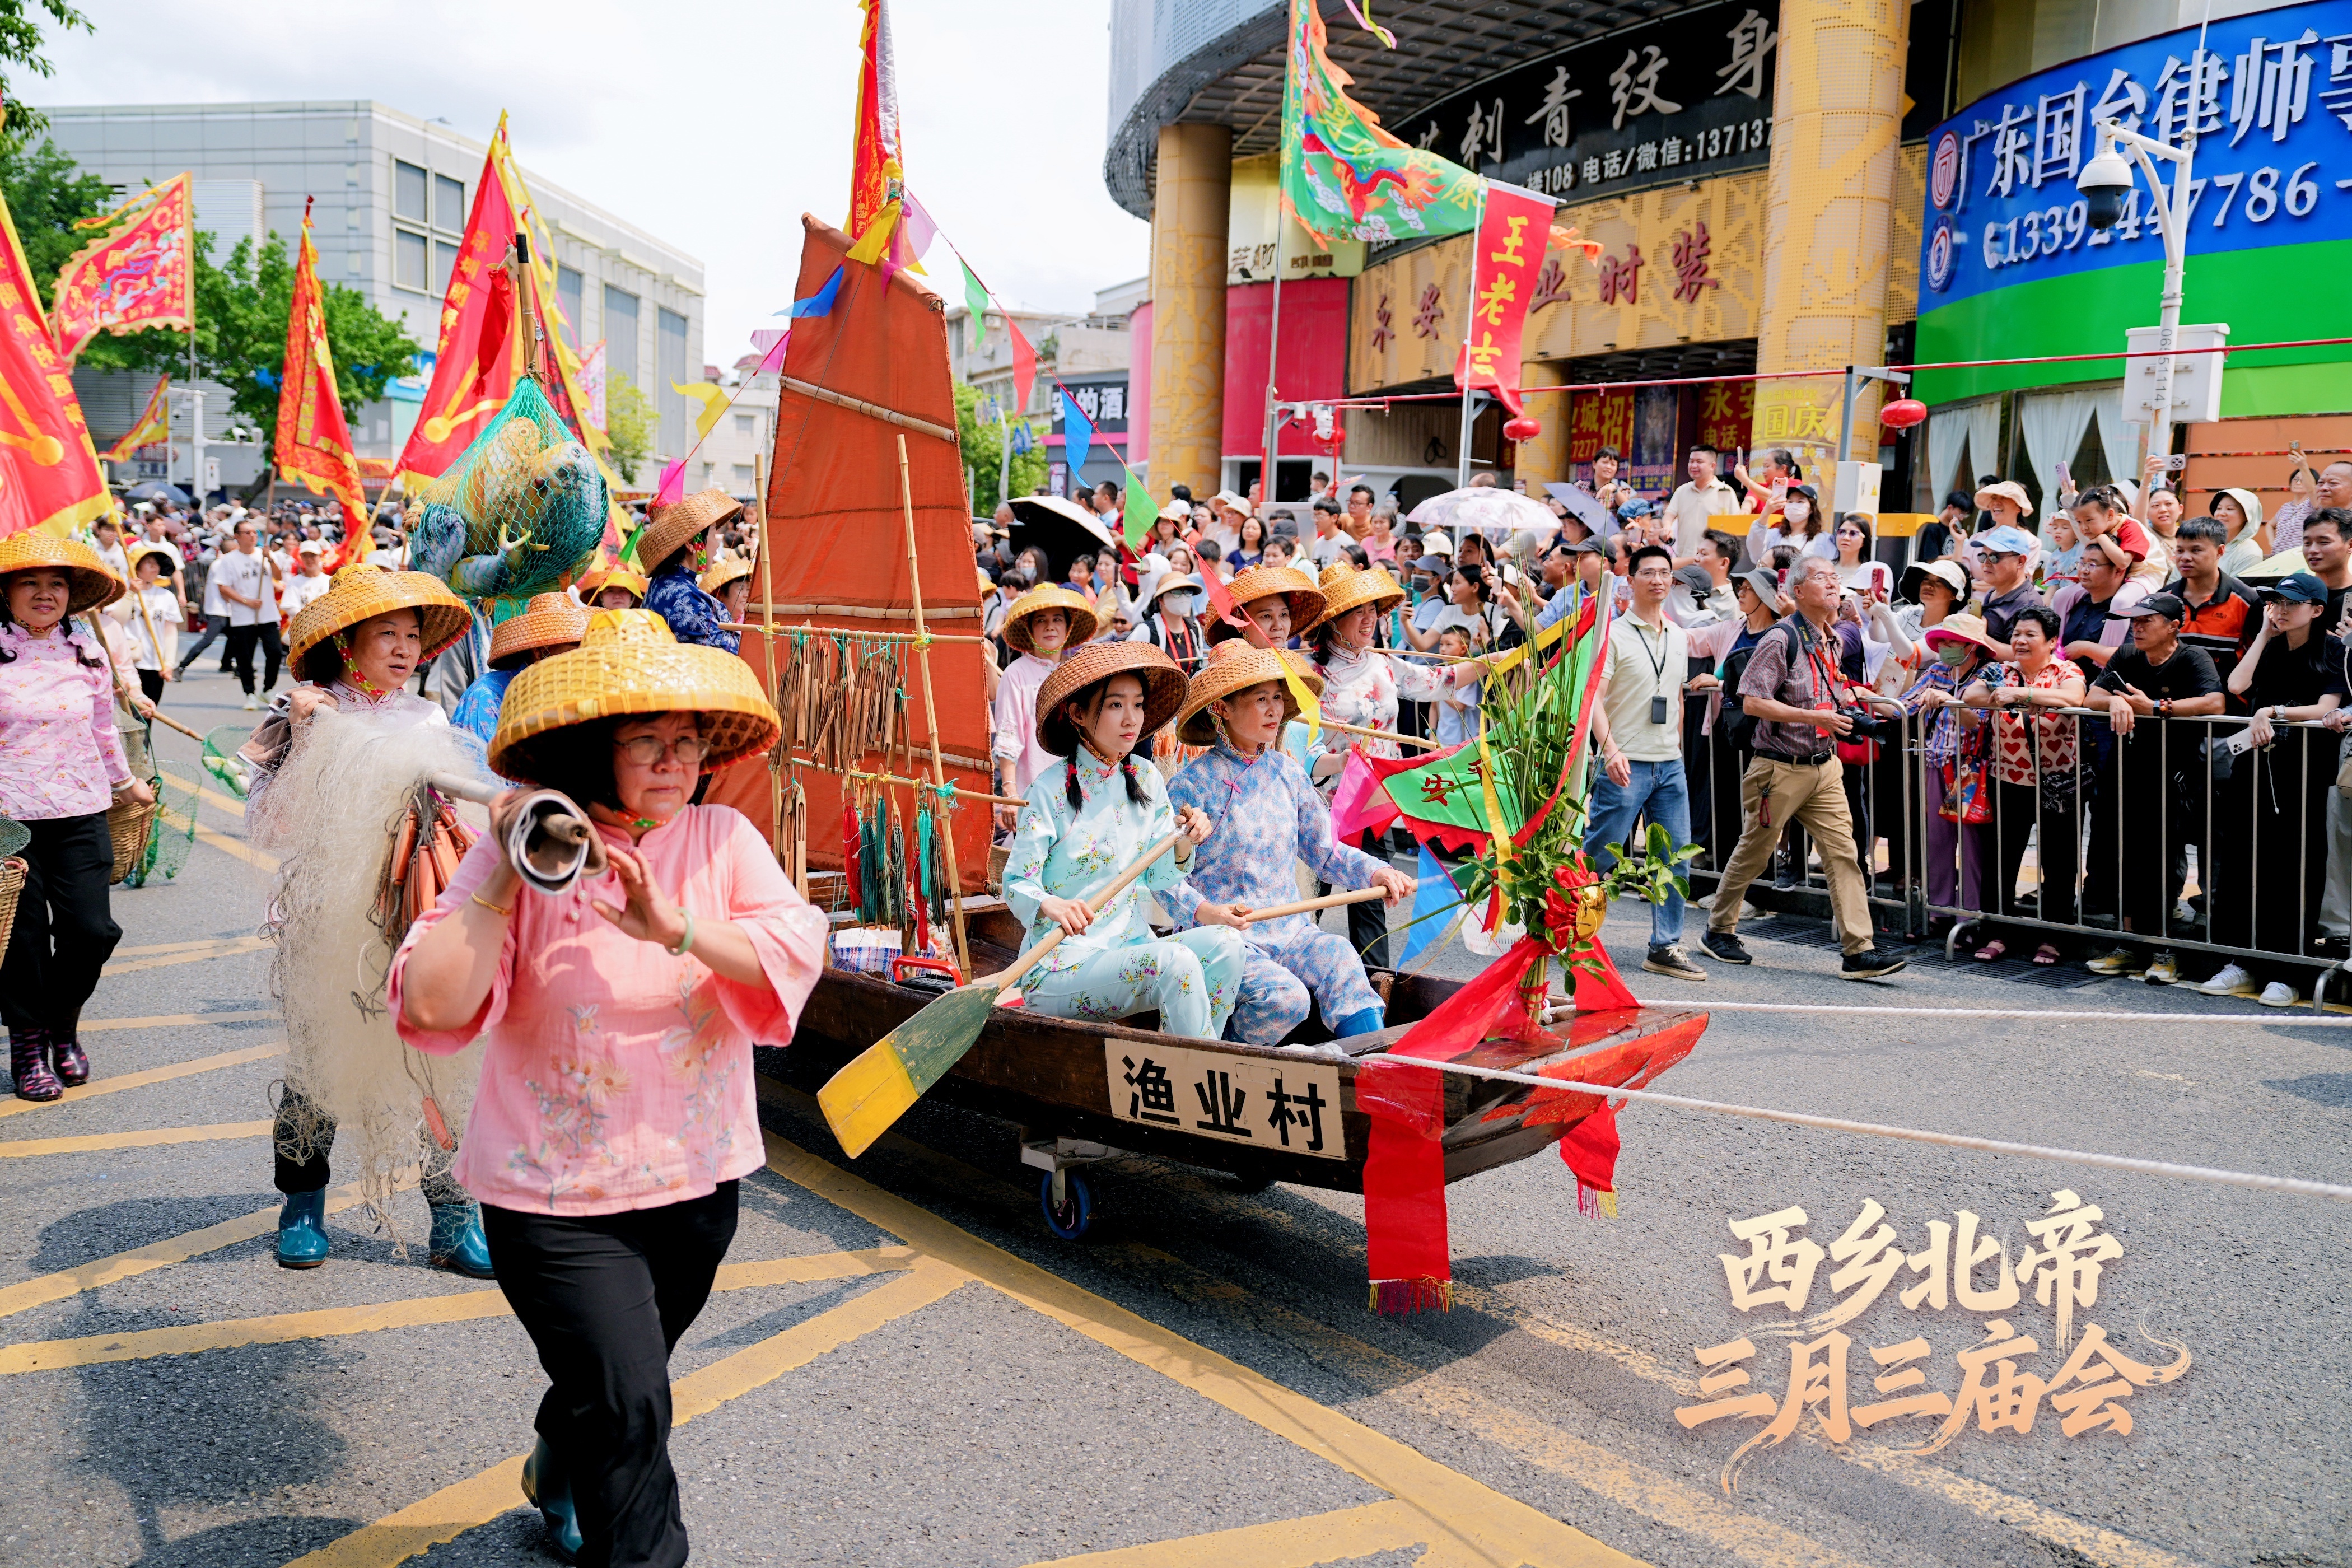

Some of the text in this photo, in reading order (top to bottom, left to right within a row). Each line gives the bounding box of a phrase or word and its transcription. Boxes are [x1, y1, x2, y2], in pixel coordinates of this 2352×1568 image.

[1372, 221, 1718, 353] 永安业时装
[1470, 215, 1529, 377] 王老吉
[1122, 1055, 1326, 1152] 渔业村
